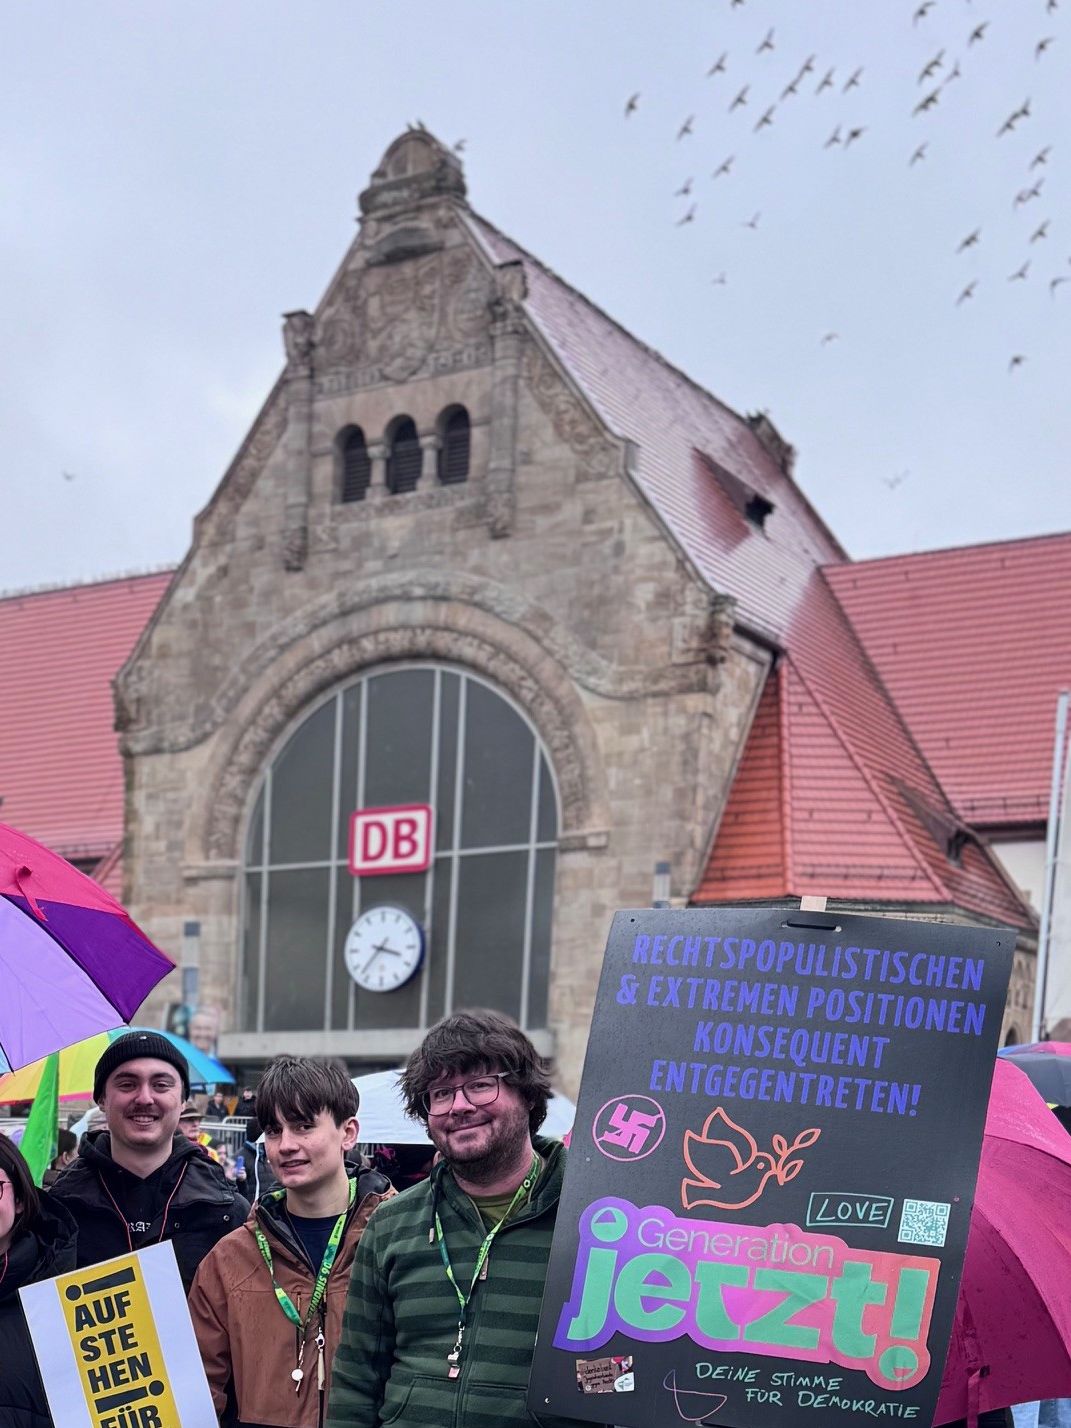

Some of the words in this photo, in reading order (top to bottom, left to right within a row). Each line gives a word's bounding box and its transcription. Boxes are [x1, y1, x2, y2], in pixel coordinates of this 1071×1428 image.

[360, 817, 418, 863] DB
[632, 935, 984, 991] RECHTSPOPULISTISCHEN
[616, 973, 640, 1005] &
[647, 975, 799, 1017] EXTREMEN
[807, 987, 987, 1035] POSITIONEN
[694, 1021, 890, 1068] KONSEQUENT
[649, 1060, 922, 1117] ENTGEGENTRETEN!
[815, 1198, 888, 1222] LOVE
[637, 1217, 834, 1268] Generation
[75, 1290, 132, 1332] AUF
[567, 1208, 929, 1382] jetzt!
[79, 1323, 139, 1362] STE
[87, 1352, 153, 1394] HEN
[745, 1388, 783, 1406] FÜR
[797, 1390, 921, 1418] DEMOKRATIE
